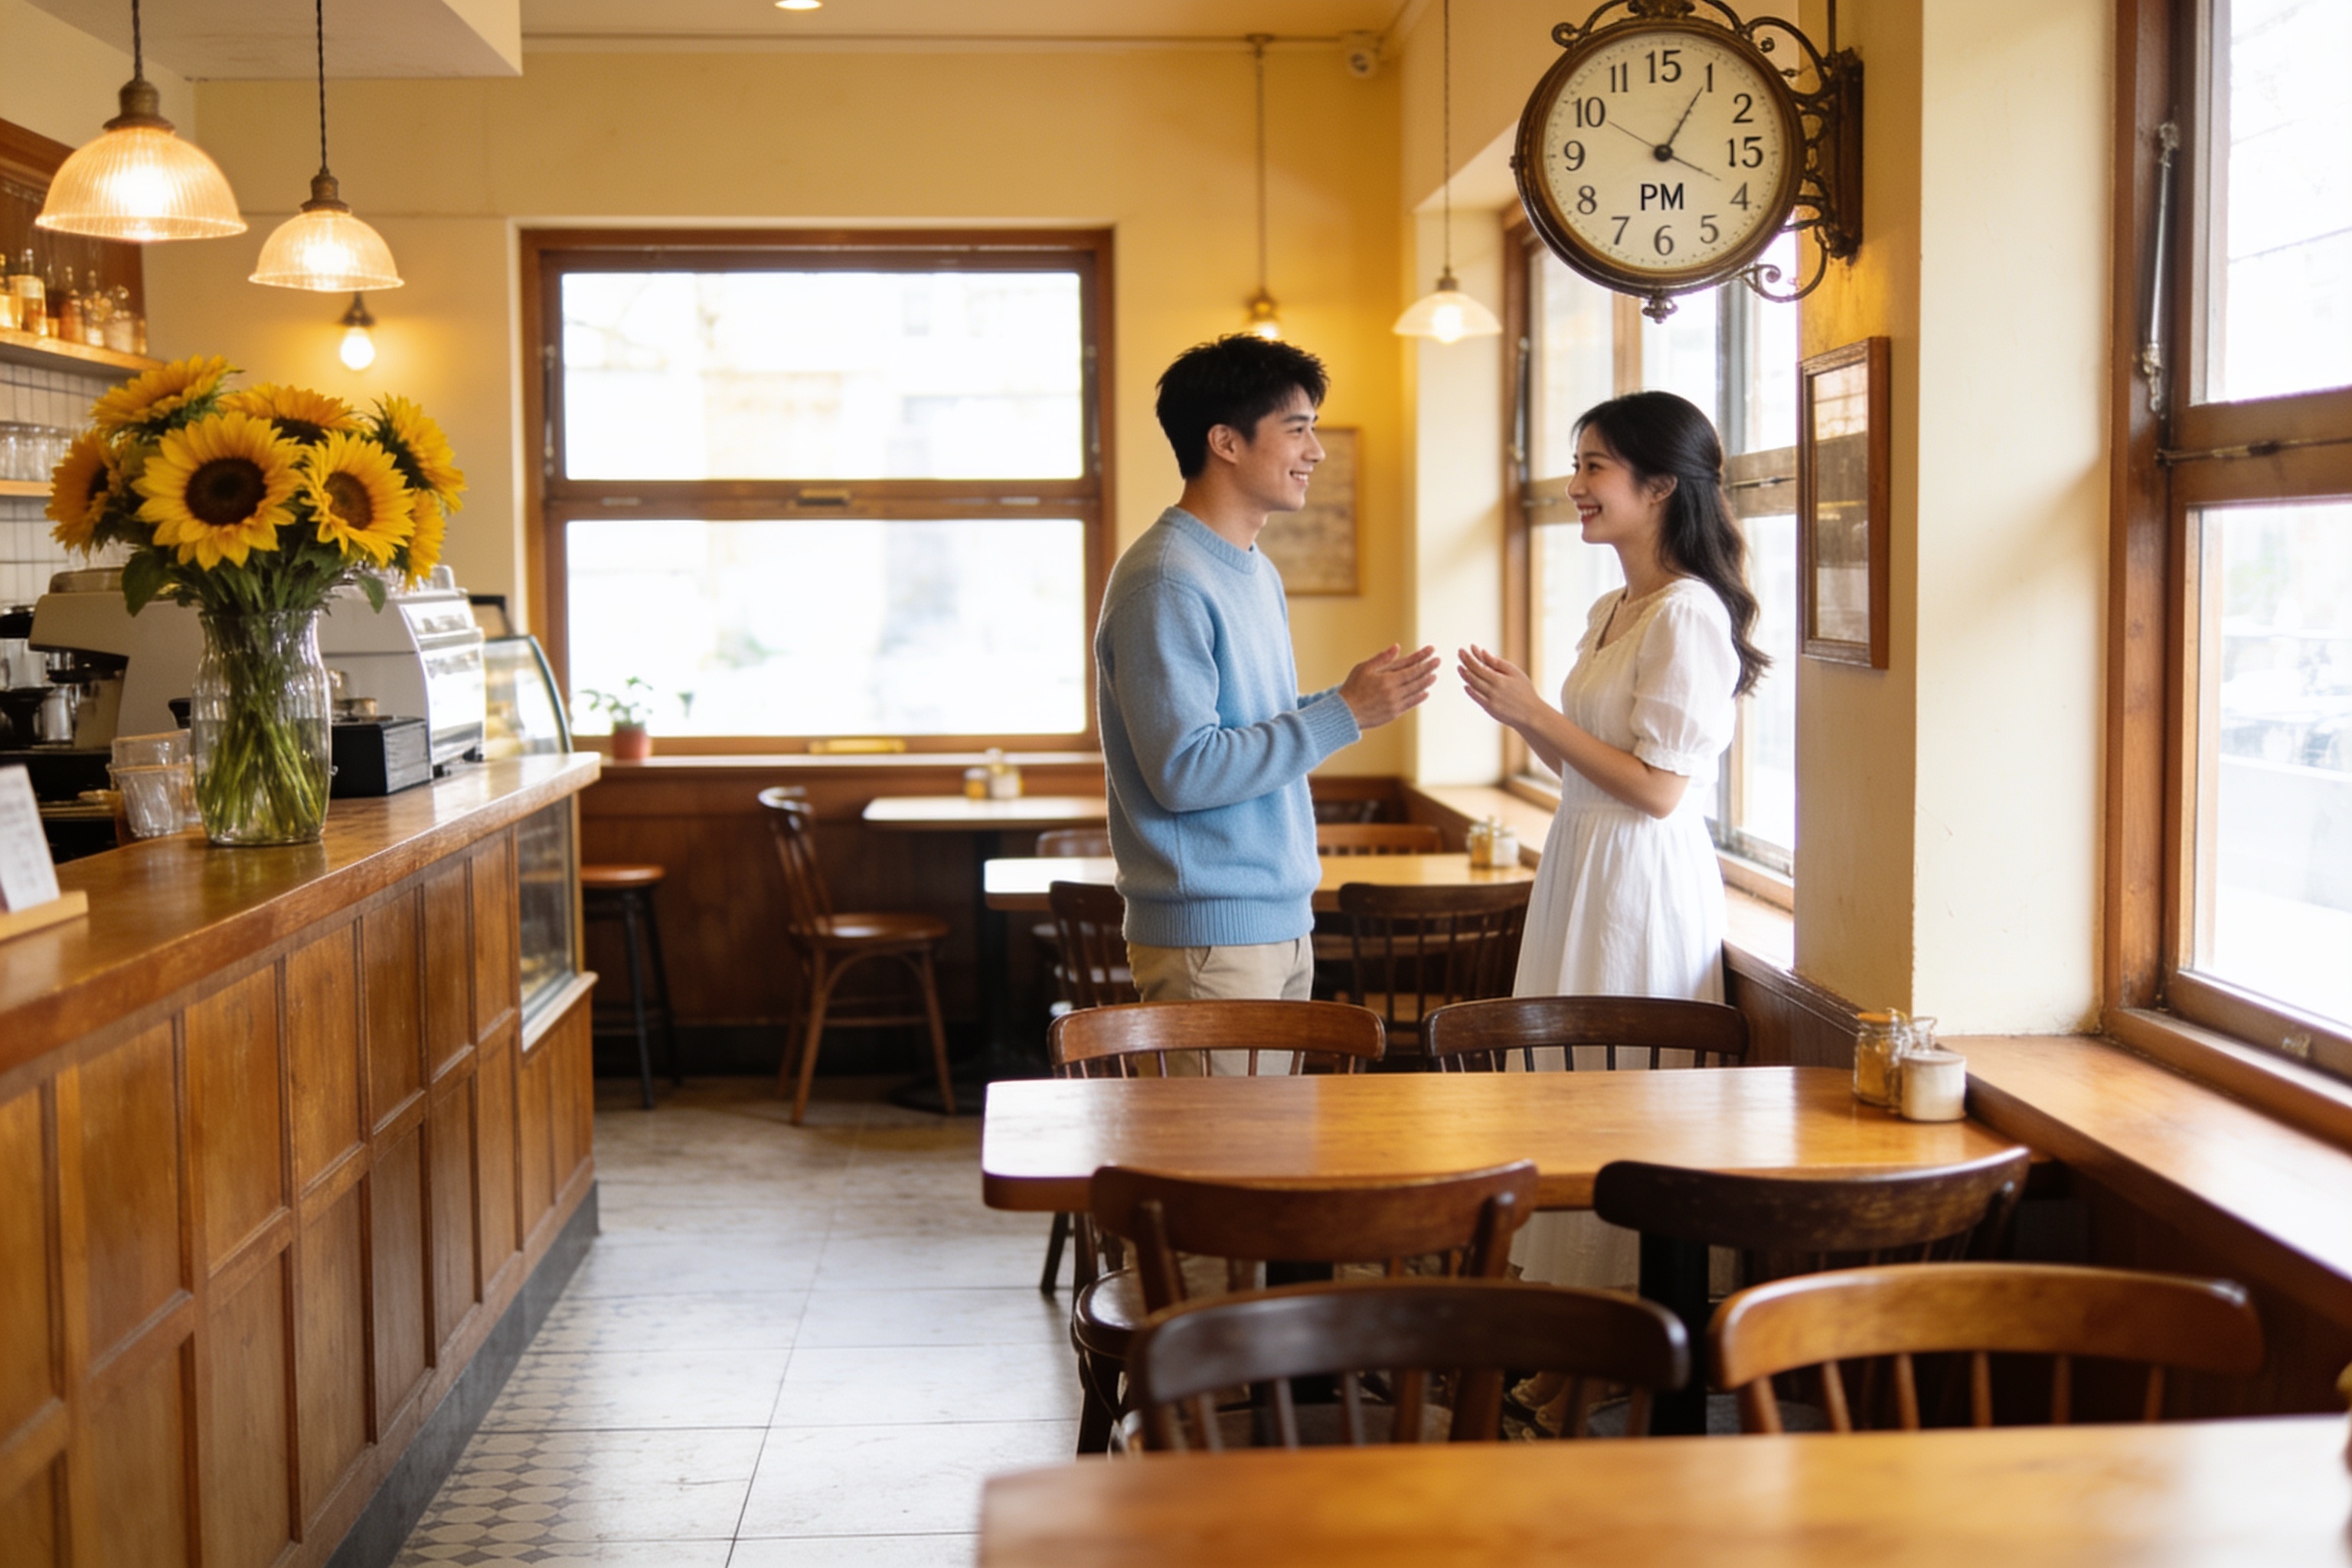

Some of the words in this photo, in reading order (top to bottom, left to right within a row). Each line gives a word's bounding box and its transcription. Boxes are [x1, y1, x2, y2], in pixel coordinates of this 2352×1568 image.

[1609, 61, 1628, 93] 11
[1645, 49, 1682, 83] 15
[1704, 62, 1713, 93] 1
[1575, 96, 1606, 128] 10
[1732, 93, 1754, 124] 2
[1563, 140, 1586, 172] 9
[1726, 136, 1764, 168] 15
[1576, 185, 1597, 215] 8
[1640, 182, 1684, 211] PM
[1730, 181, 1750, 211] 4
[1611, 216, 1631, 246] 7
[1653, 224, 1674, 256] 6
[1700, 214, 1720, 244] 5
